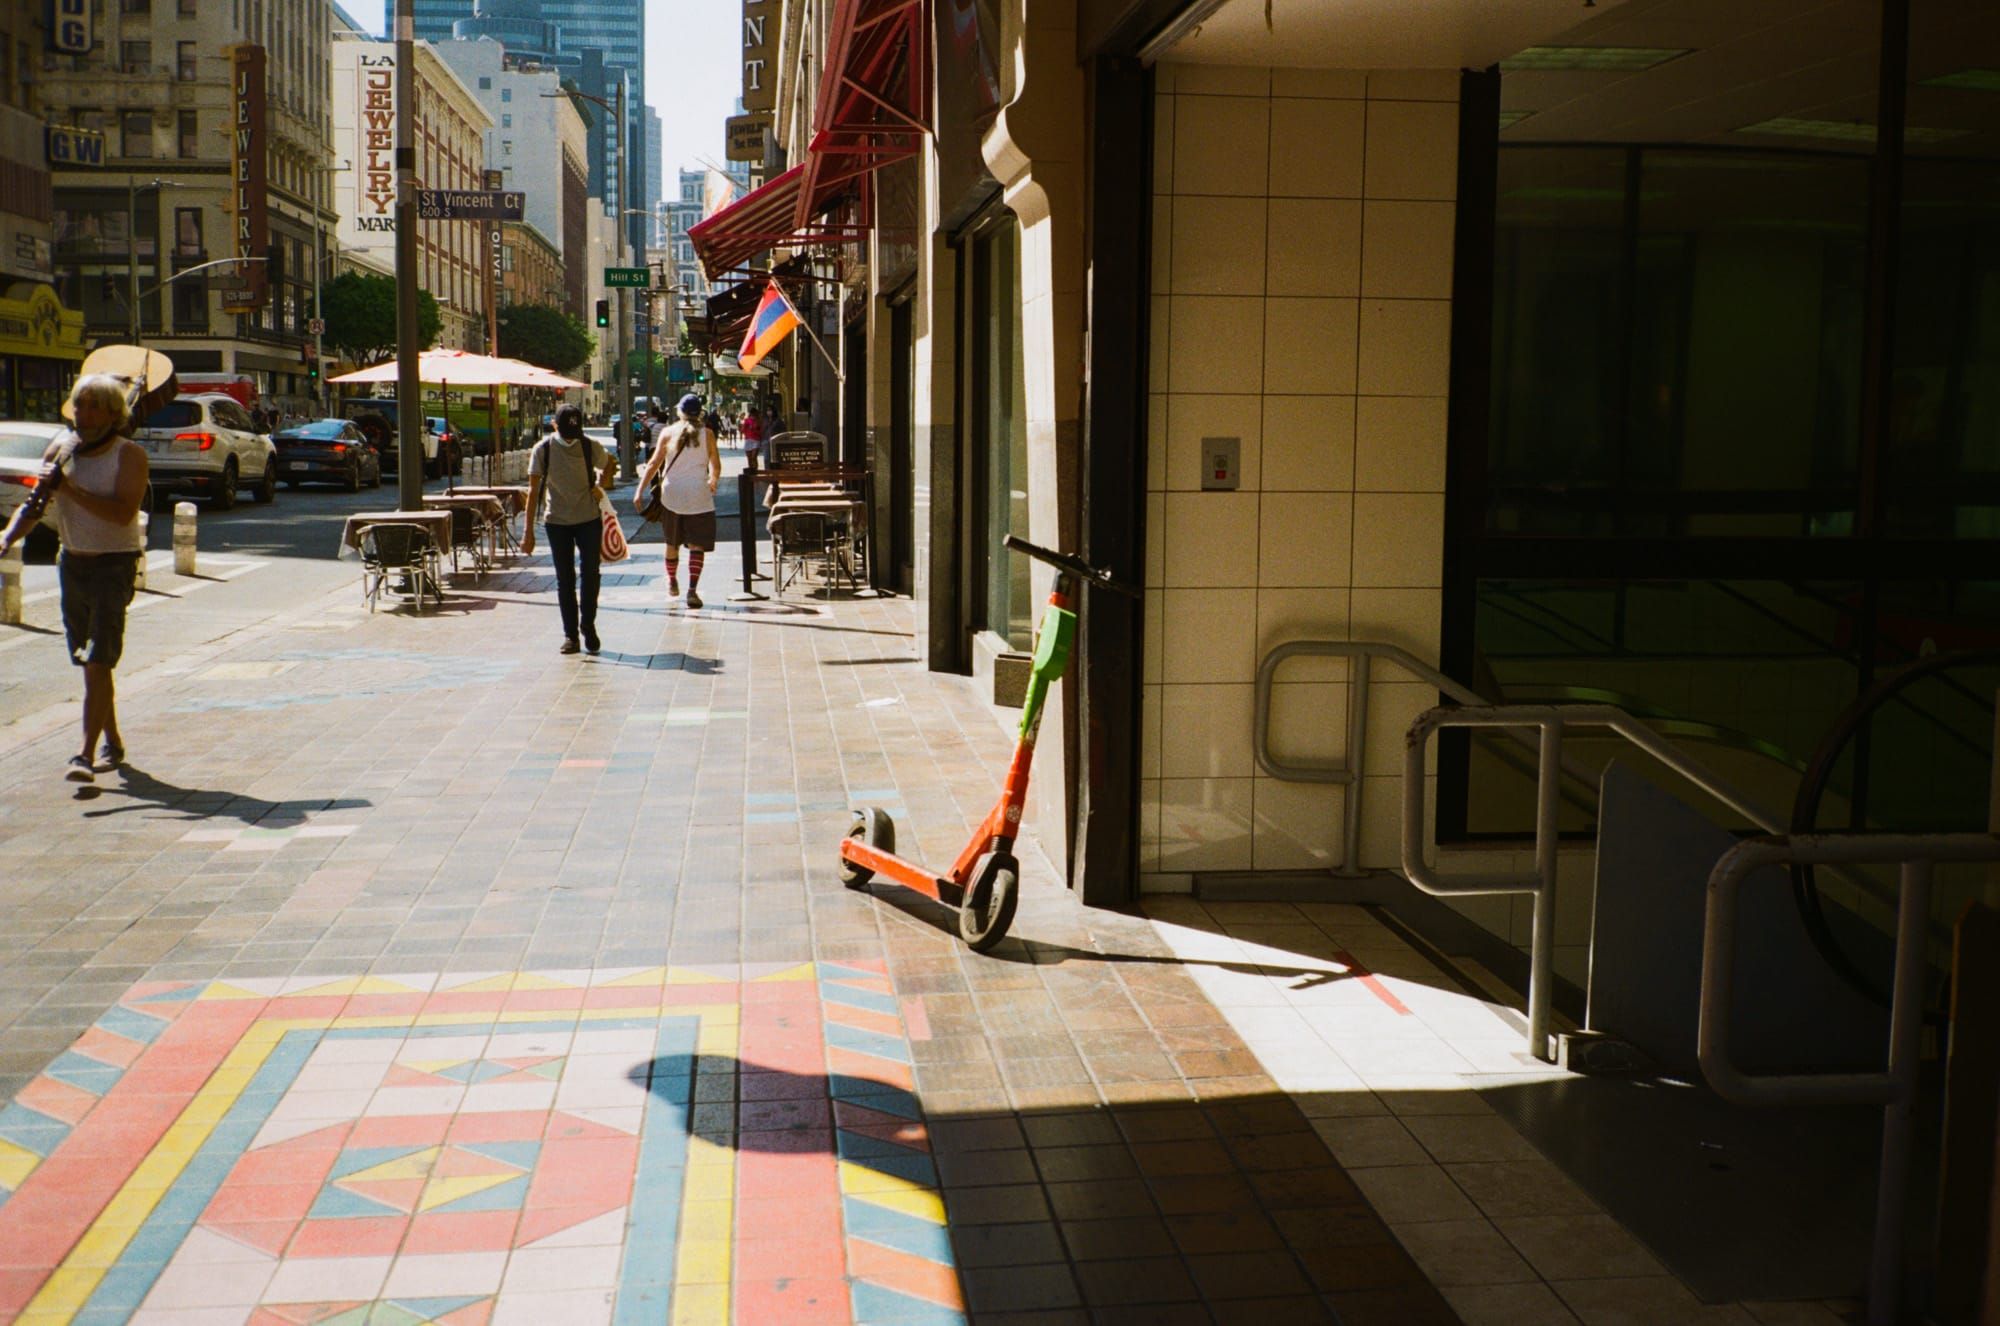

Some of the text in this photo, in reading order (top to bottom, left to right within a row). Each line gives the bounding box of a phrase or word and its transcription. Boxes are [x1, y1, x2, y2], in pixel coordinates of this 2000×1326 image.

[744, 0, 765, 90] NT
[361, 55, 395, 66] LA
[53, 132, 102, 163] GW
[363, 70, 395, 214] JEWELRY
[236, 71, 251, 268] JEWELRY
[422, 192, 520, 209] St Vincent Ct
[422, 207, 451, 217] 600 S
[357, 217, 396, 231] MAR
[610, 273, 644, 282] Hill St
